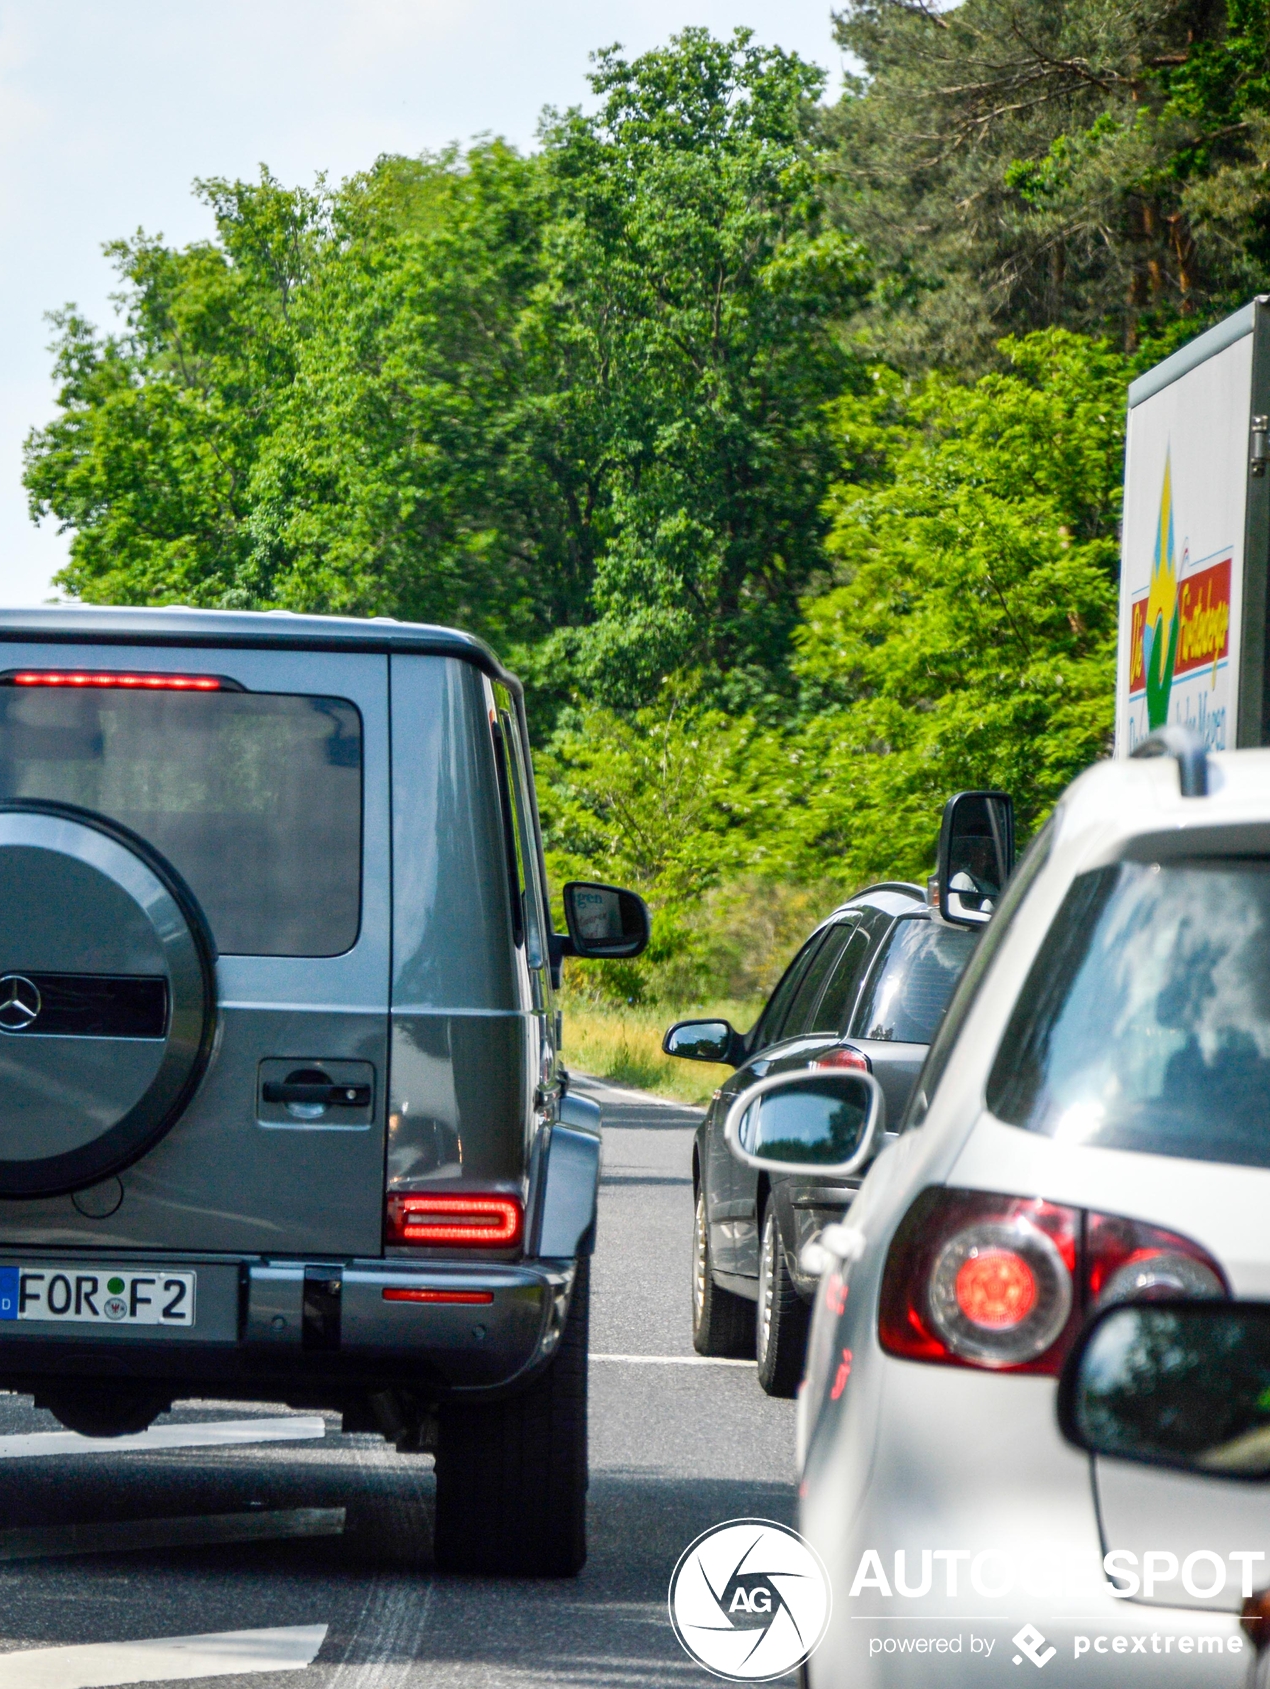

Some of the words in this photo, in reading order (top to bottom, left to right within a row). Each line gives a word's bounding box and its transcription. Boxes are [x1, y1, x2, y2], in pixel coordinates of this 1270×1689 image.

[1, 1298, 11, 1311] D
[19, 1273, 100, 1316] FOR
[129, 1278, 187, 1319] F2
